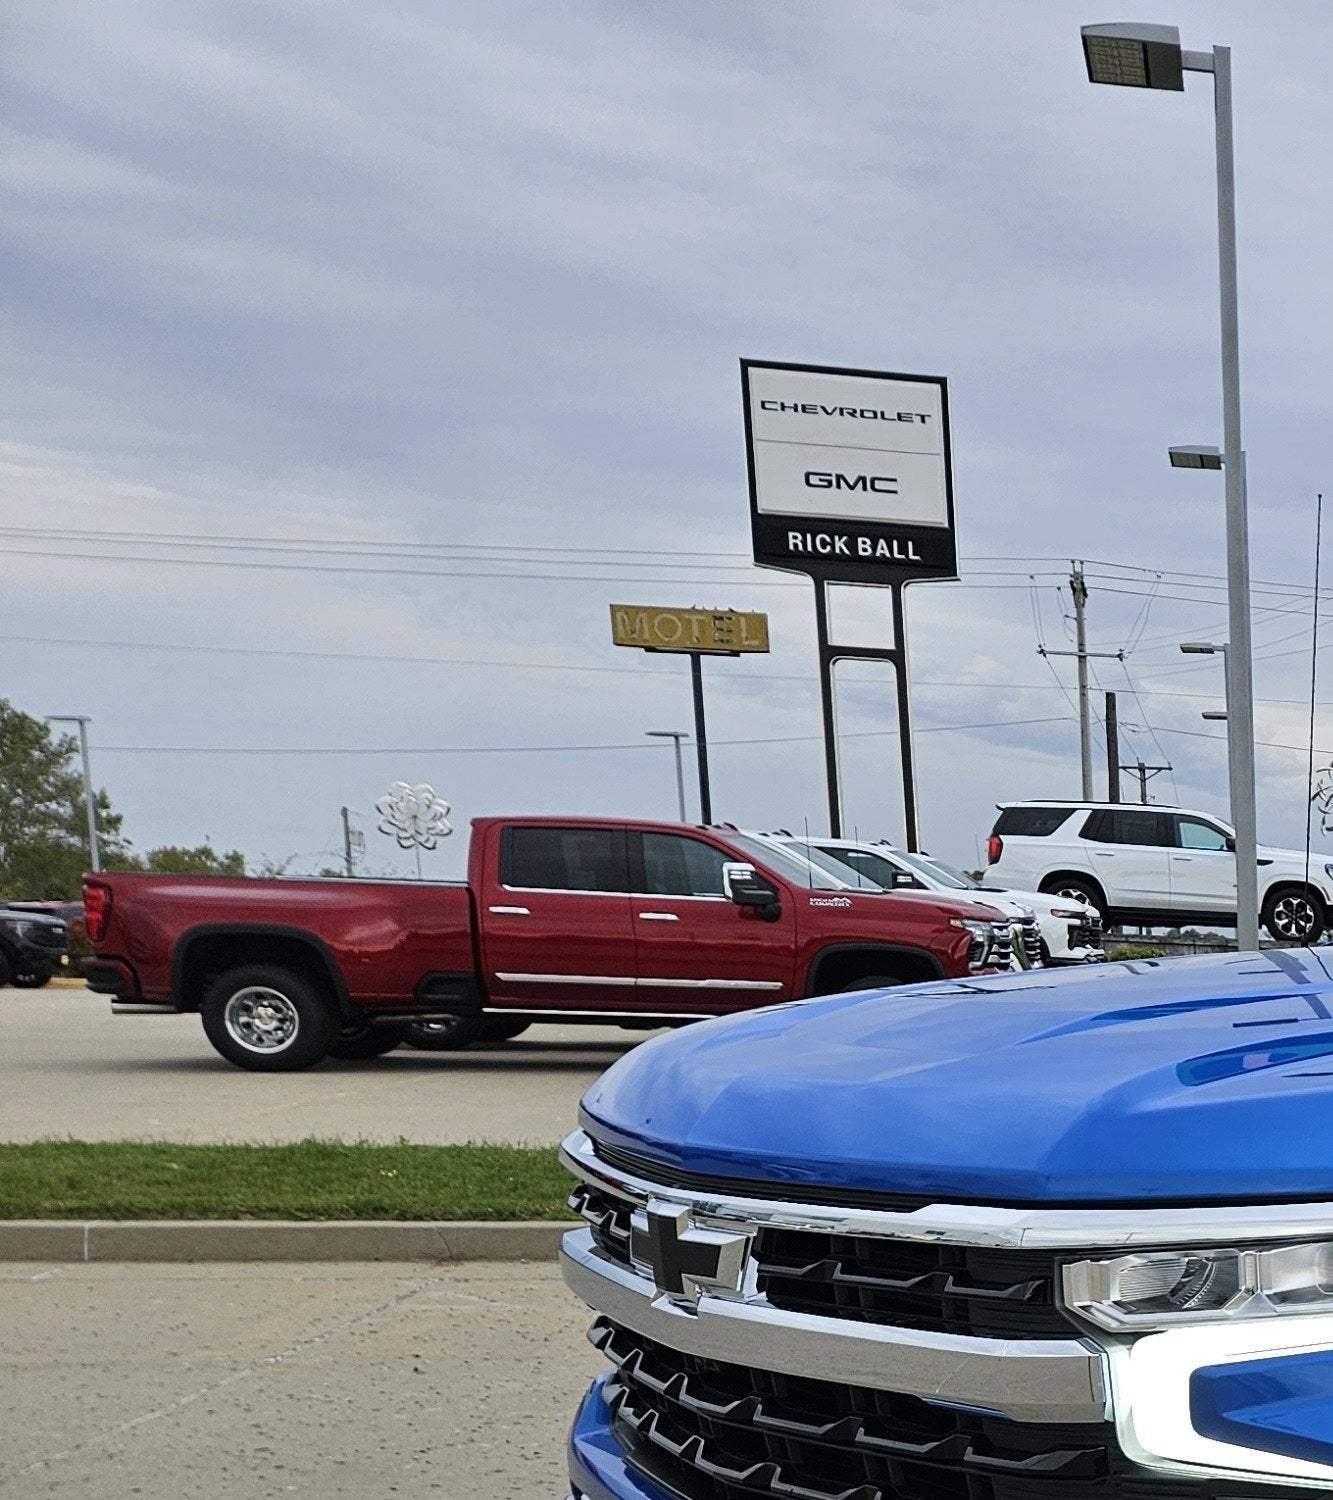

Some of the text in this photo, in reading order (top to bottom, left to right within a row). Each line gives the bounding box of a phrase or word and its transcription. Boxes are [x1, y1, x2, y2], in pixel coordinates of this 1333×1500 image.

[760, 400, 932, 424] CHEVROLET
[804, 471, 898, 494] GMC
[787, 531, 922, 561] RICK BALL
[615, 611, 761, 646] MOTEL
